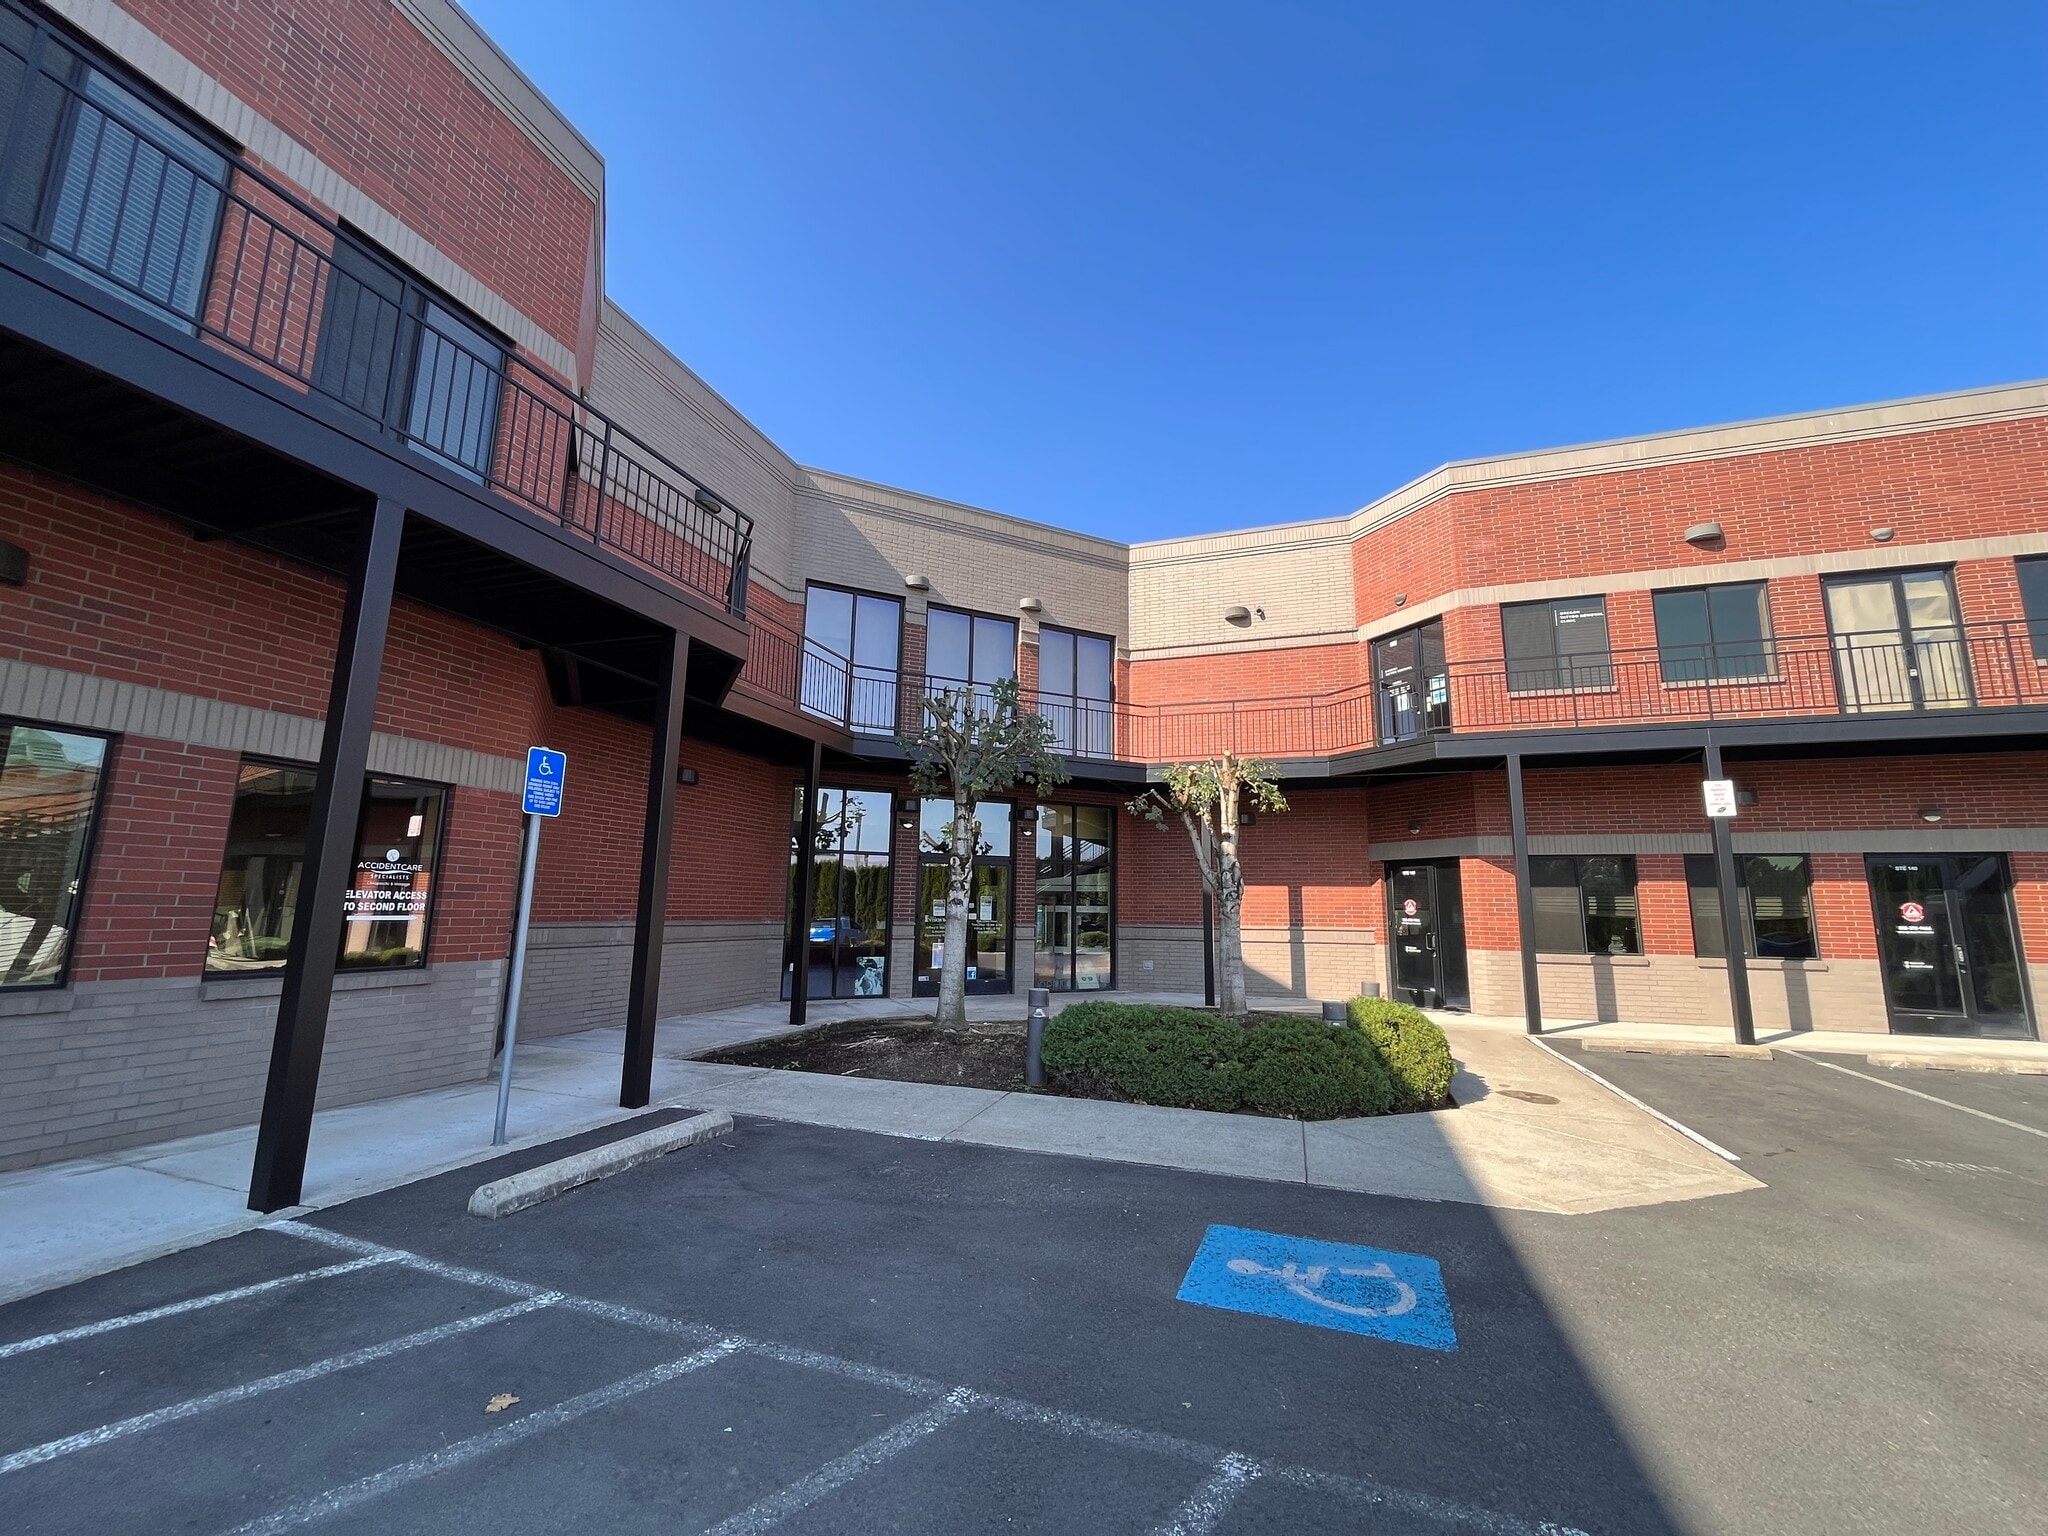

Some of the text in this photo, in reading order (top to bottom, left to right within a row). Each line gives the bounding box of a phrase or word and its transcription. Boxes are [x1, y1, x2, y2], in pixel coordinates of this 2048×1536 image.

[357, 862, 423, 871] ACCIDENTCARE
[345, 889, 427, 900] ELEVATOR ACCESS
[357, 902, 395, 911] SECOND
[397, 902, 426, 911] FLOOR
